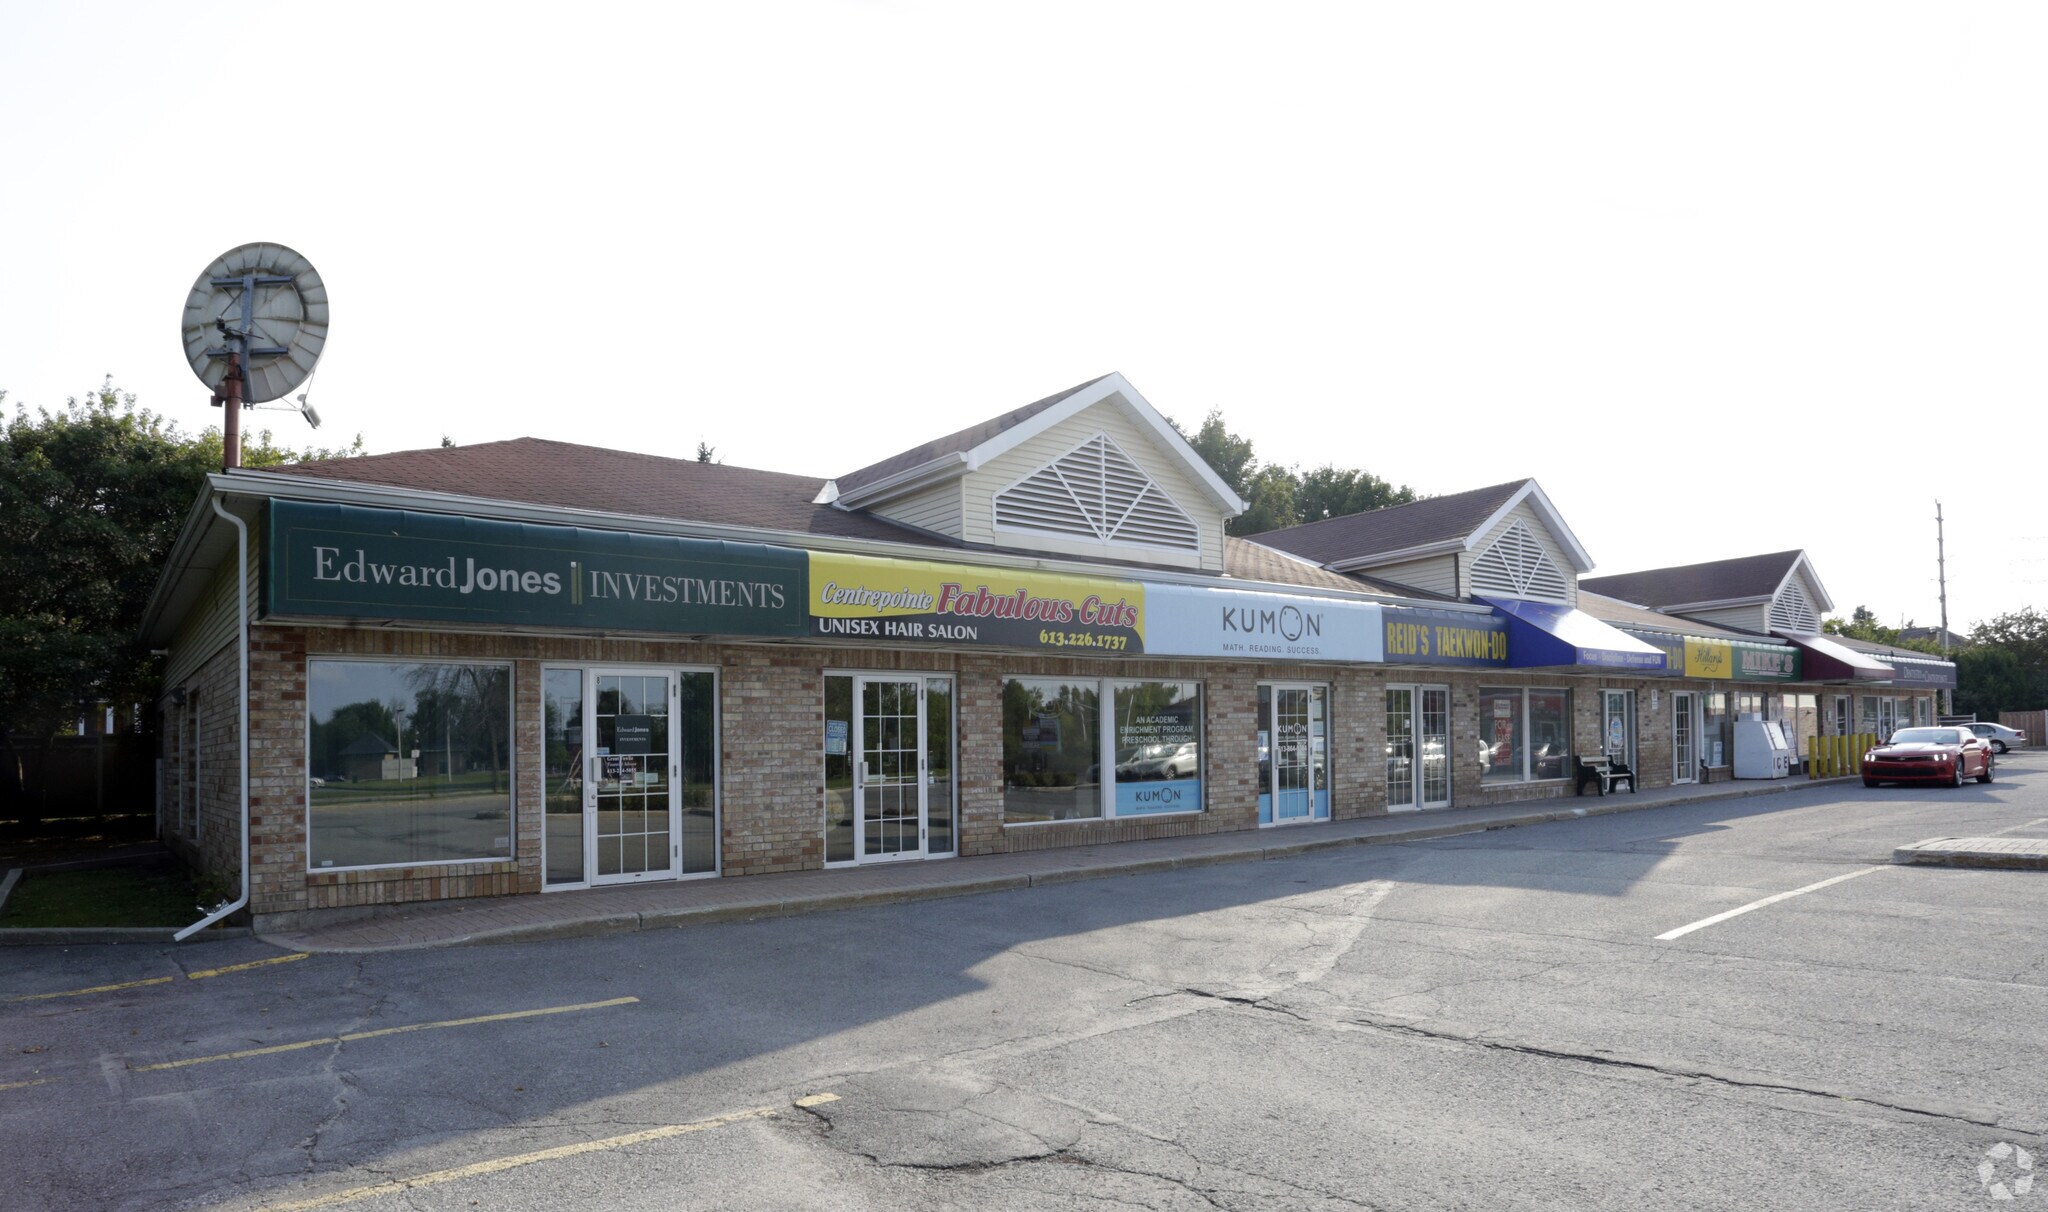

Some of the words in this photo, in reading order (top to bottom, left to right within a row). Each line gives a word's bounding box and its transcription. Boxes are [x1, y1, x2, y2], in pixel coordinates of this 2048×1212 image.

[589, 570, 786, 609] INVESTMENTS
[820, 581, 934, 613] Centrepointe
[936, 583, 1074, 624] Fabulous
[1078, 595, 1139, 628] Cuts
[819, 618, 879, 636] UNISEX
[884, 621, 923, 638] HAIR
[928, 623, 978, 640] SALON
[1222, 605, 1321, 641] KUMON
[1039, 630, 1128, 650] 613.226.1737
[1387, 622, 1430, 656] REID'S
[1436, 626, 1508, 661] TAEKWON-DO
[1741, 650, 1794, 673] MIKE'S
[1120, 725, 1161, 734] ENRICHMENT
[1162, 725, 1194, 733] PROGRAM
[1135, 716, 1145, 724] AN
[1146, 715, 1179, 724] ACADEMIC
[1121, 735, 1162, 744] PRESCHOOL
[1162, 735, 1192, 743] THROUGH
[1773, 756, 1788, 770] ICE
[1135, 787, 1181, 803] KUMON
